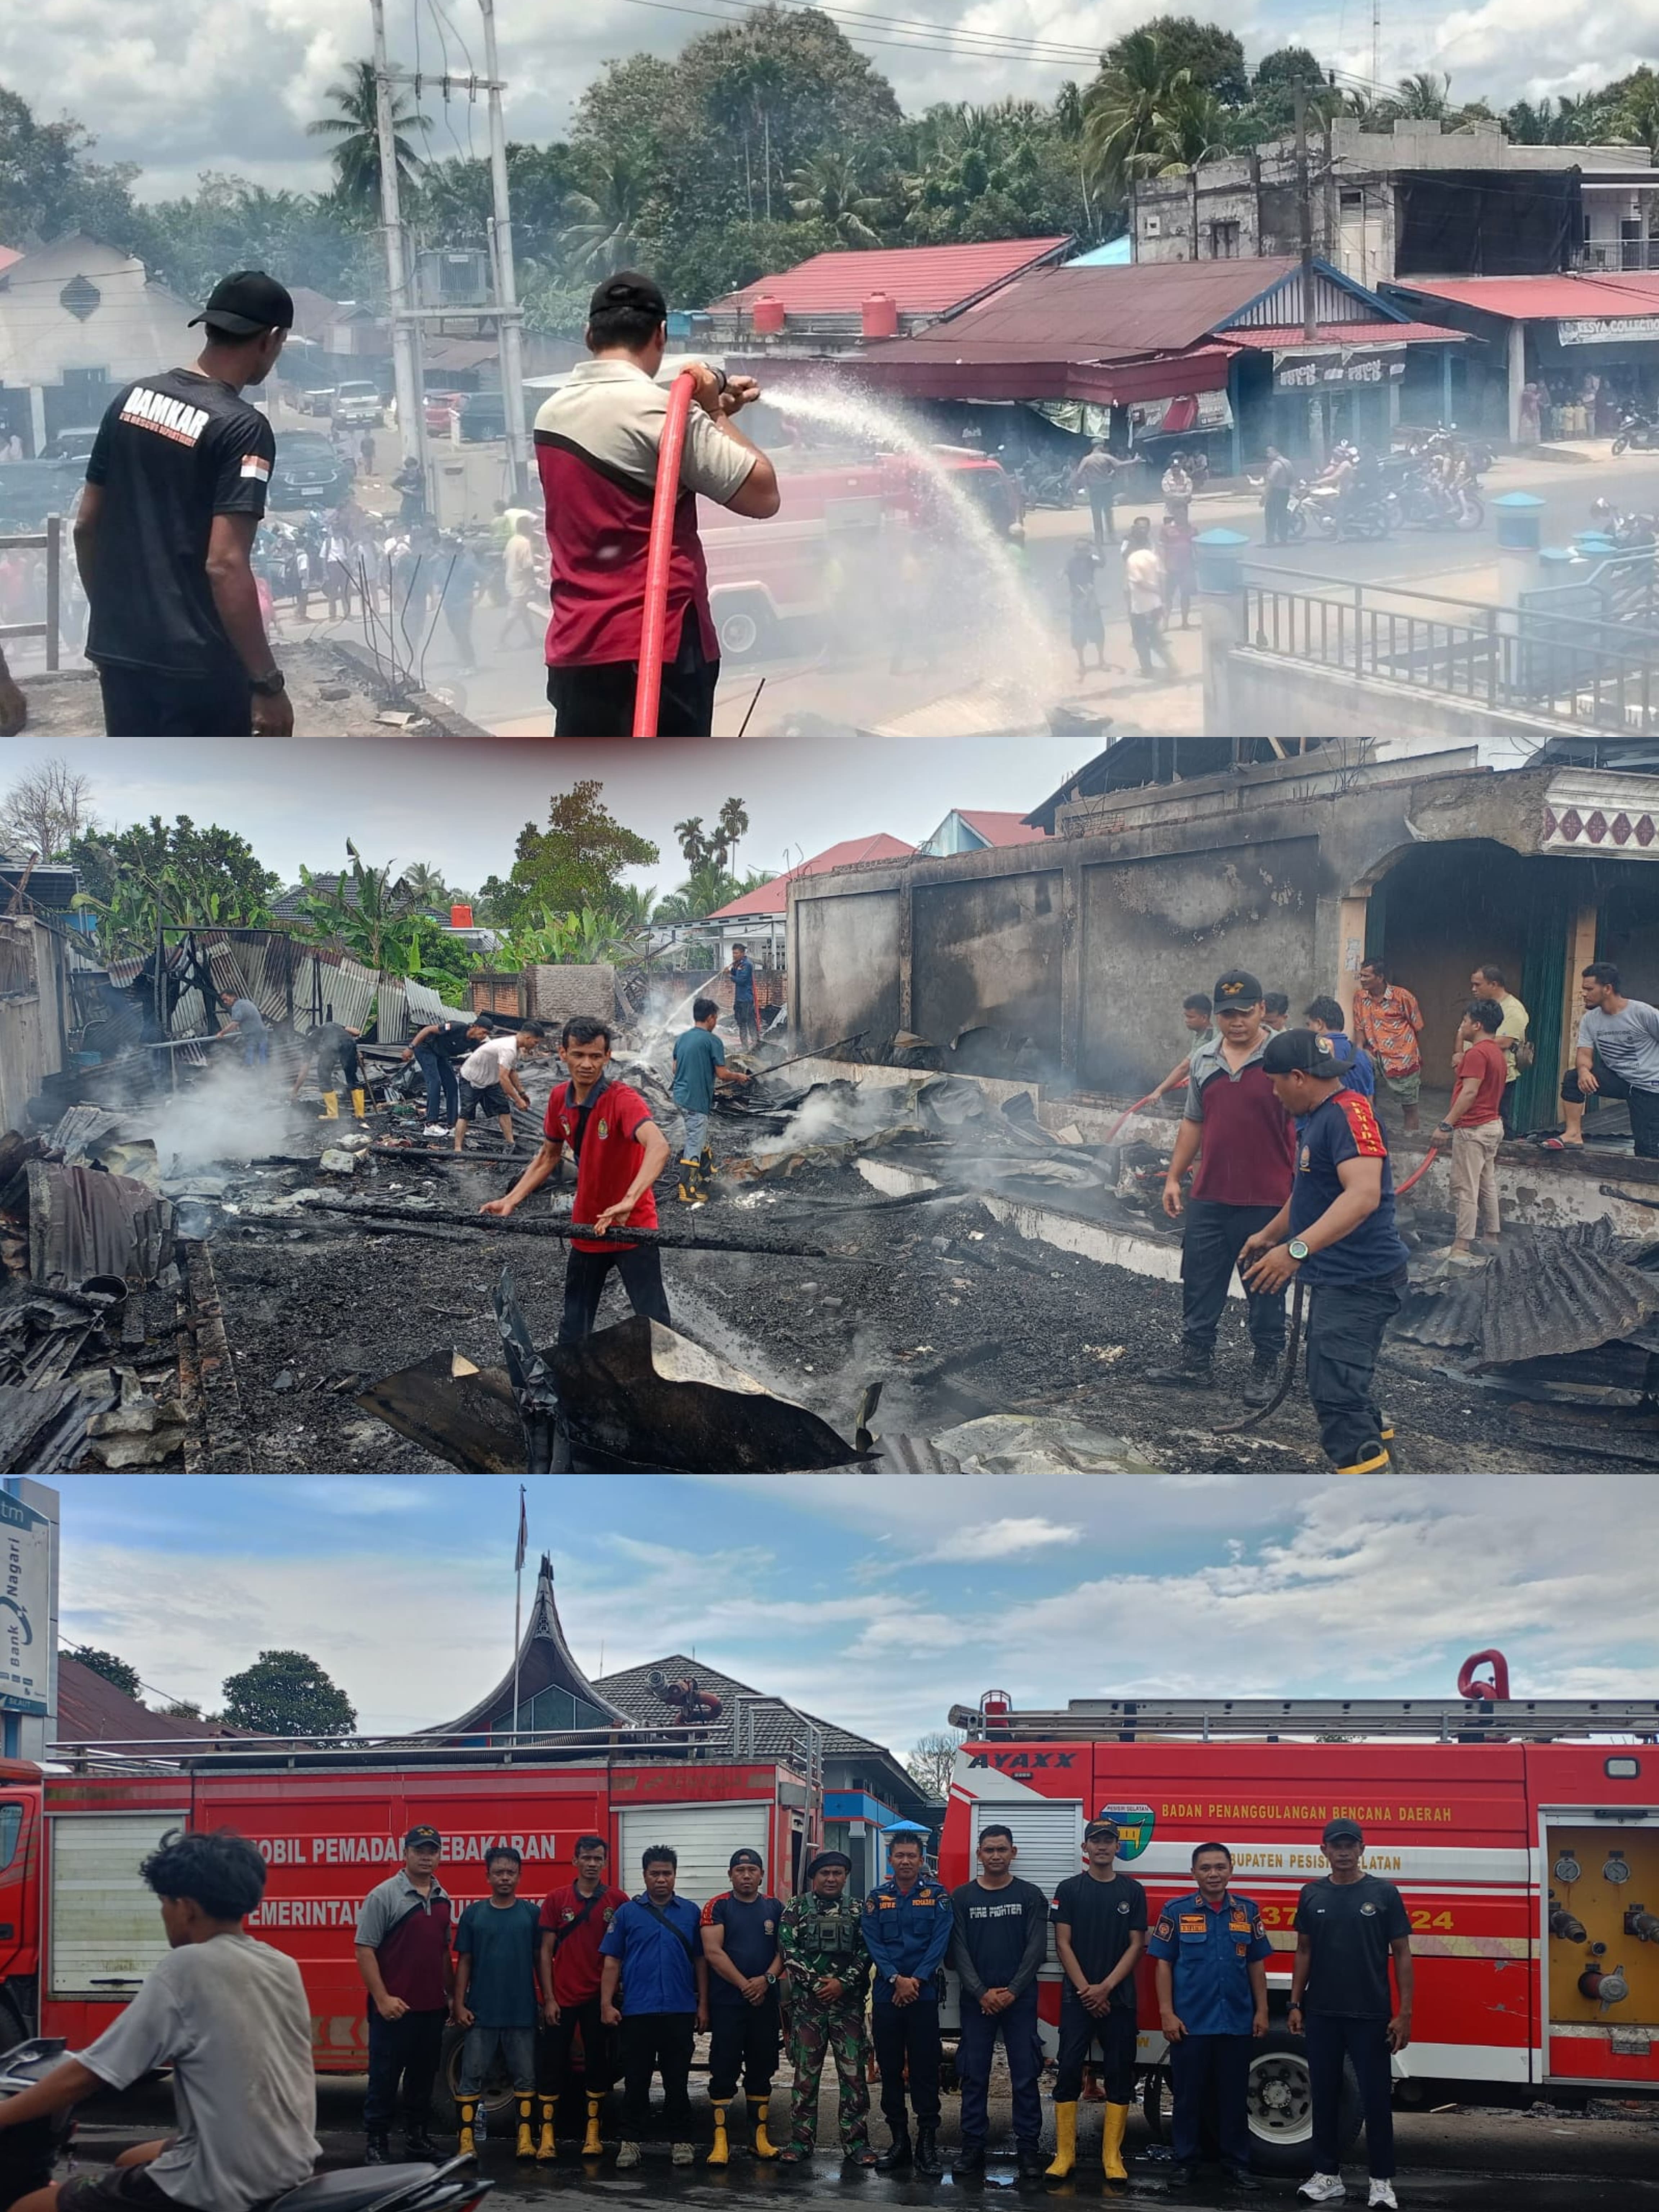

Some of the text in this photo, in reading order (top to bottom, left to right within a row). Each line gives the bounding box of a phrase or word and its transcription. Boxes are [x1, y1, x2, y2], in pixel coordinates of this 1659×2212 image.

[123, 386, 210, 440] DAMKAR
[7, 1537, 22, 1597] Nagari
[8, 1625, 19, 1667] Bank
[967, 1753, 1077, 1768] AYAXX
[1162, 1804, 1451, 1821] BADAN PENANGGULANGAN BENCANA DAERAH
[252, 1839, 306, 1863] OBIL
[441, 1835, 555, 1861] EBAKARAN
[1231, 1853, 1401, 1870] BUPATEN PESISI LATAN
[248, 1901, 361, 1926] EMERINTA
